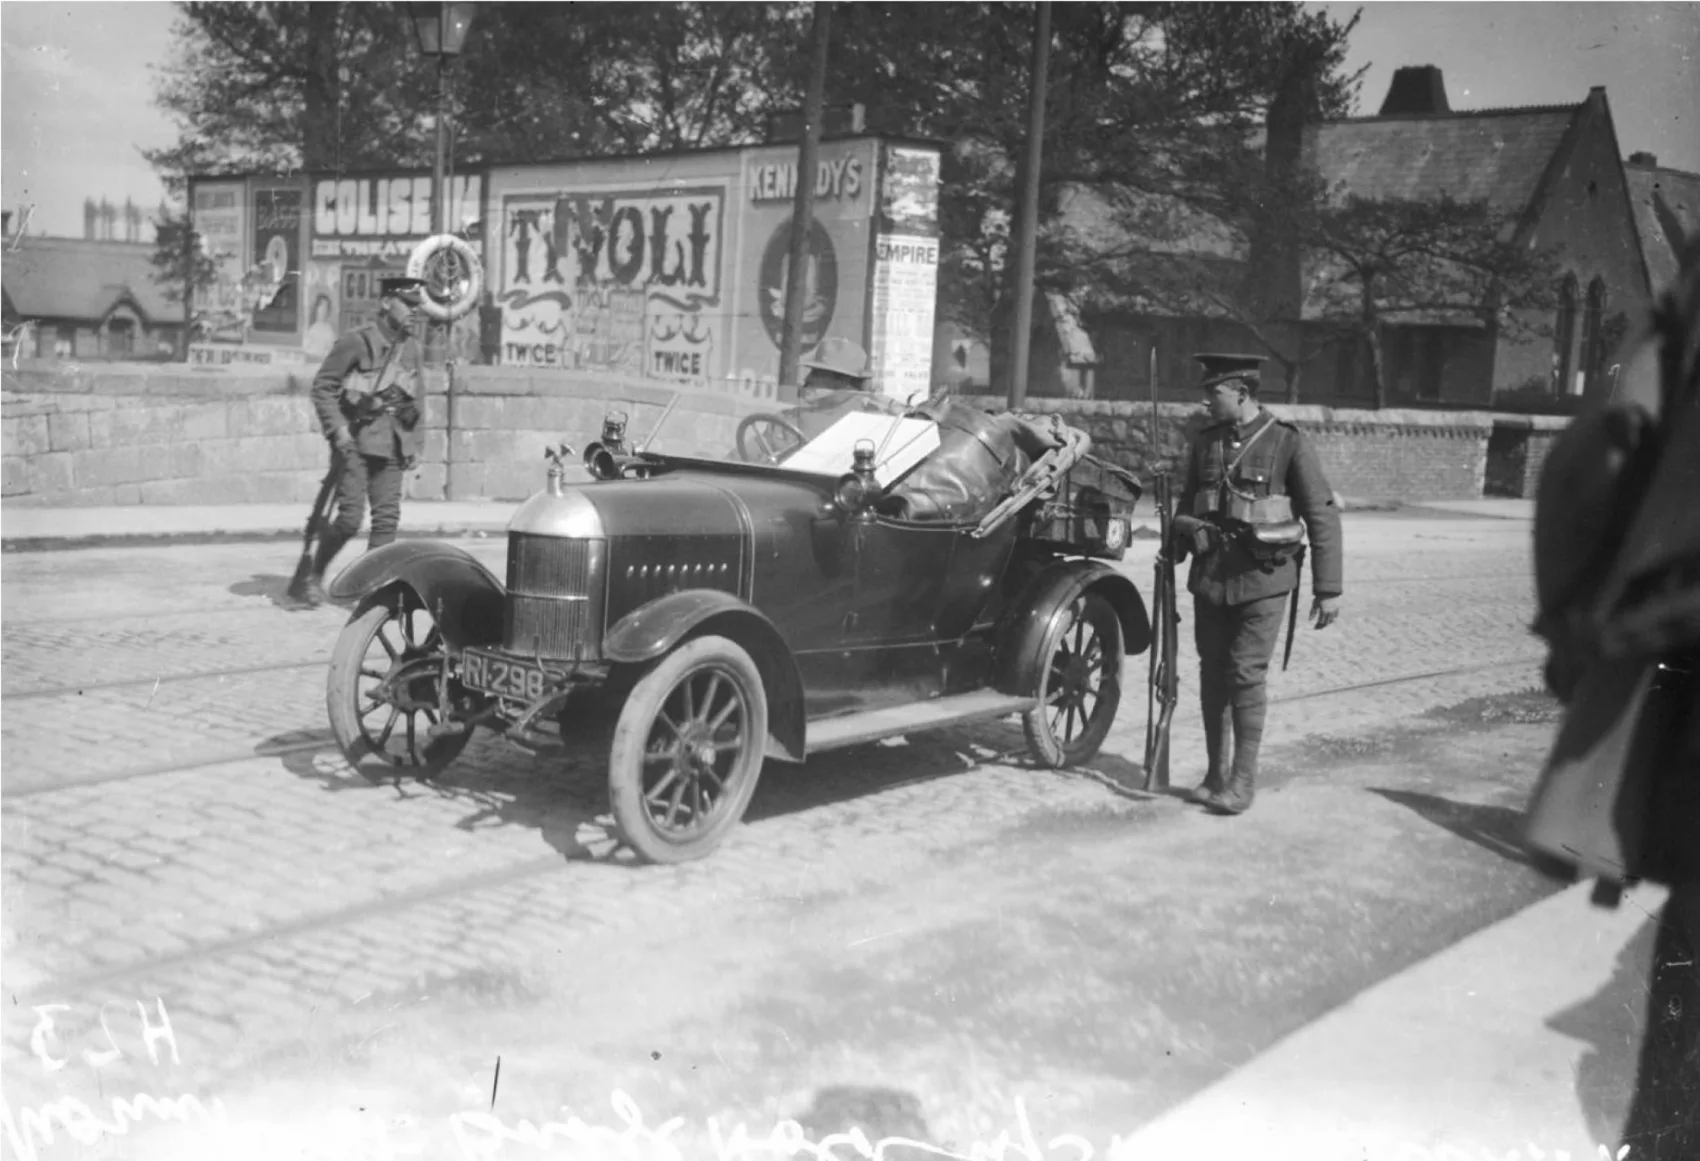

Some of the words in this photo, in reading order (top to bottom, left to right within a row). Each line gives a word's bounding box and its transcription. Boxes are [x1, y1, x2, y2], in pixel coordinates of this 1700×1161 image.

[315, 175, 482, 235] COLISEM
[508, 200, 713, 288] TIVOLI
[876, 243, 937, 265] EMPIRE
[654, 351, 700, 375] TWICE
